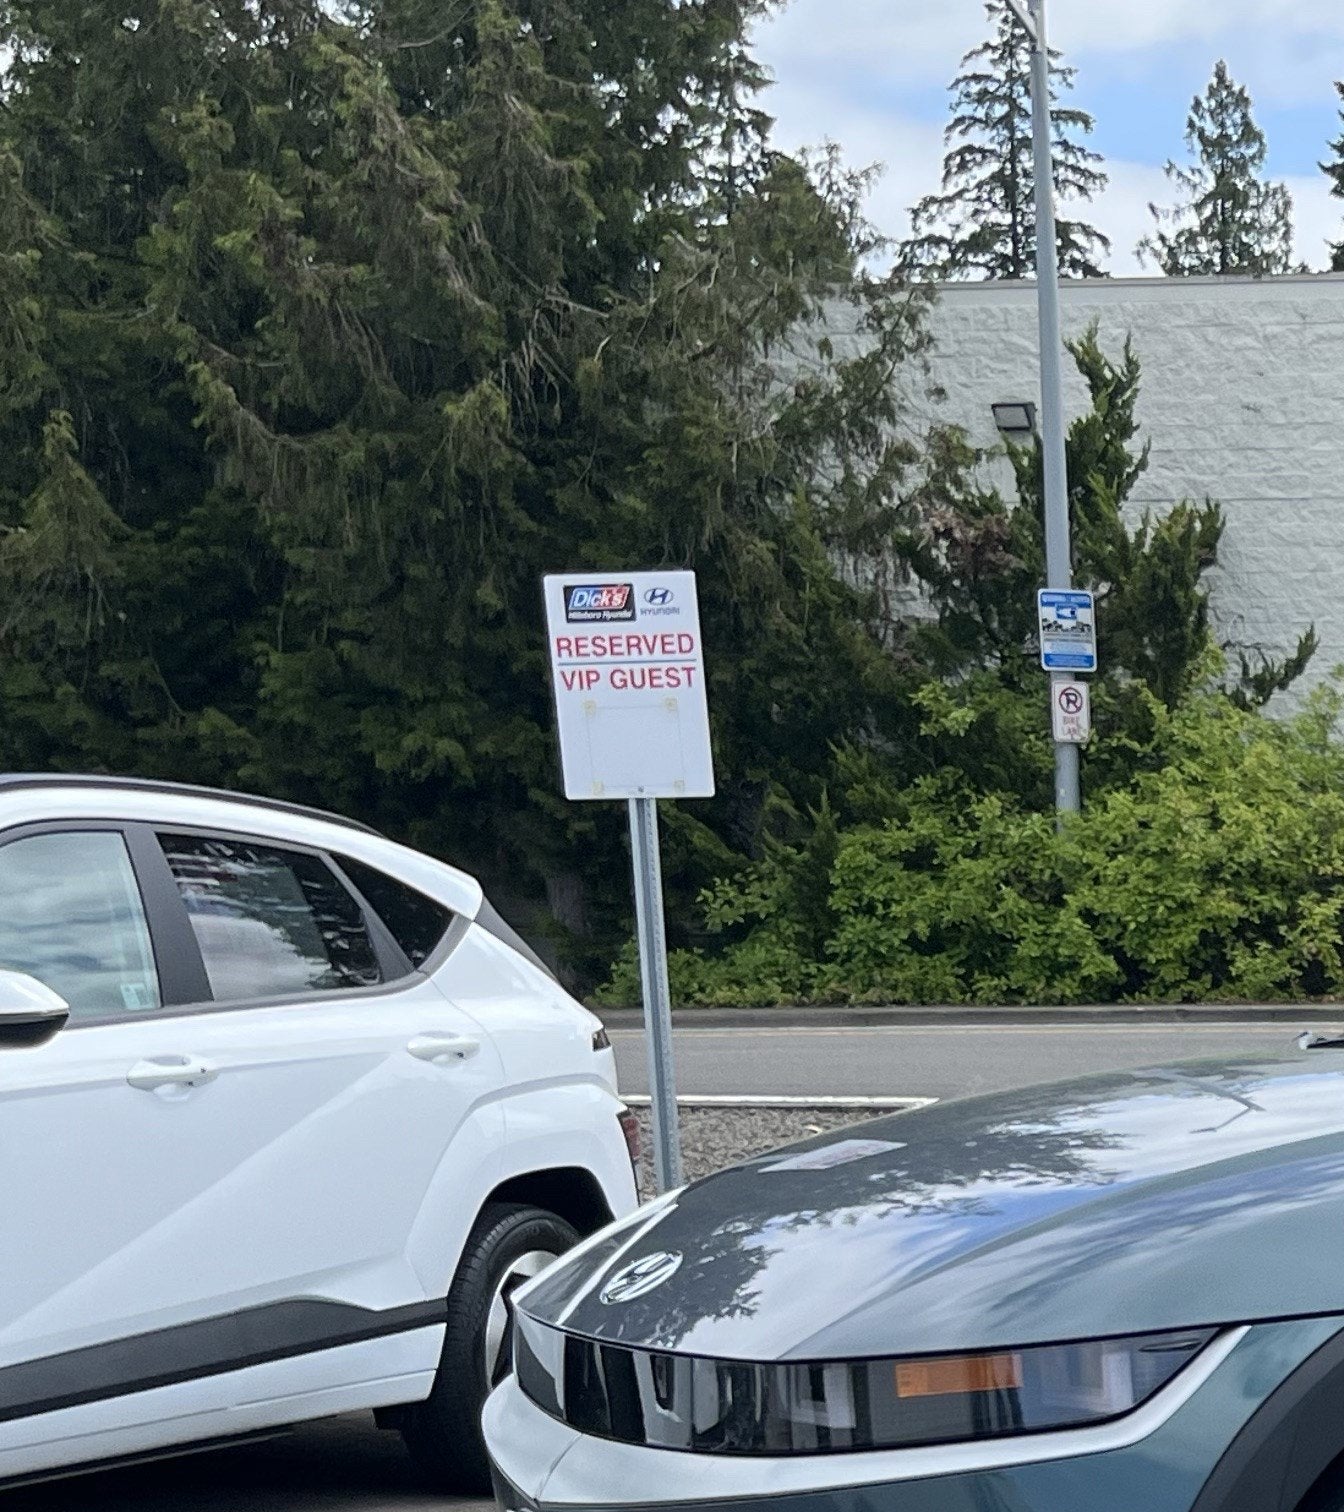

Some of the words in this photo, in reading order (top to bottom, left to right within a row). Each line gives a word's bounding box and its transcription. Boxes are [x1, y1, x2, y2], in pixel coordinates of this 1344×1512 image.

[556, 633, 694, 658] RESERVED
[560, 669, 601, 691] VIP
[609, 667, 696, 690] GUEST
